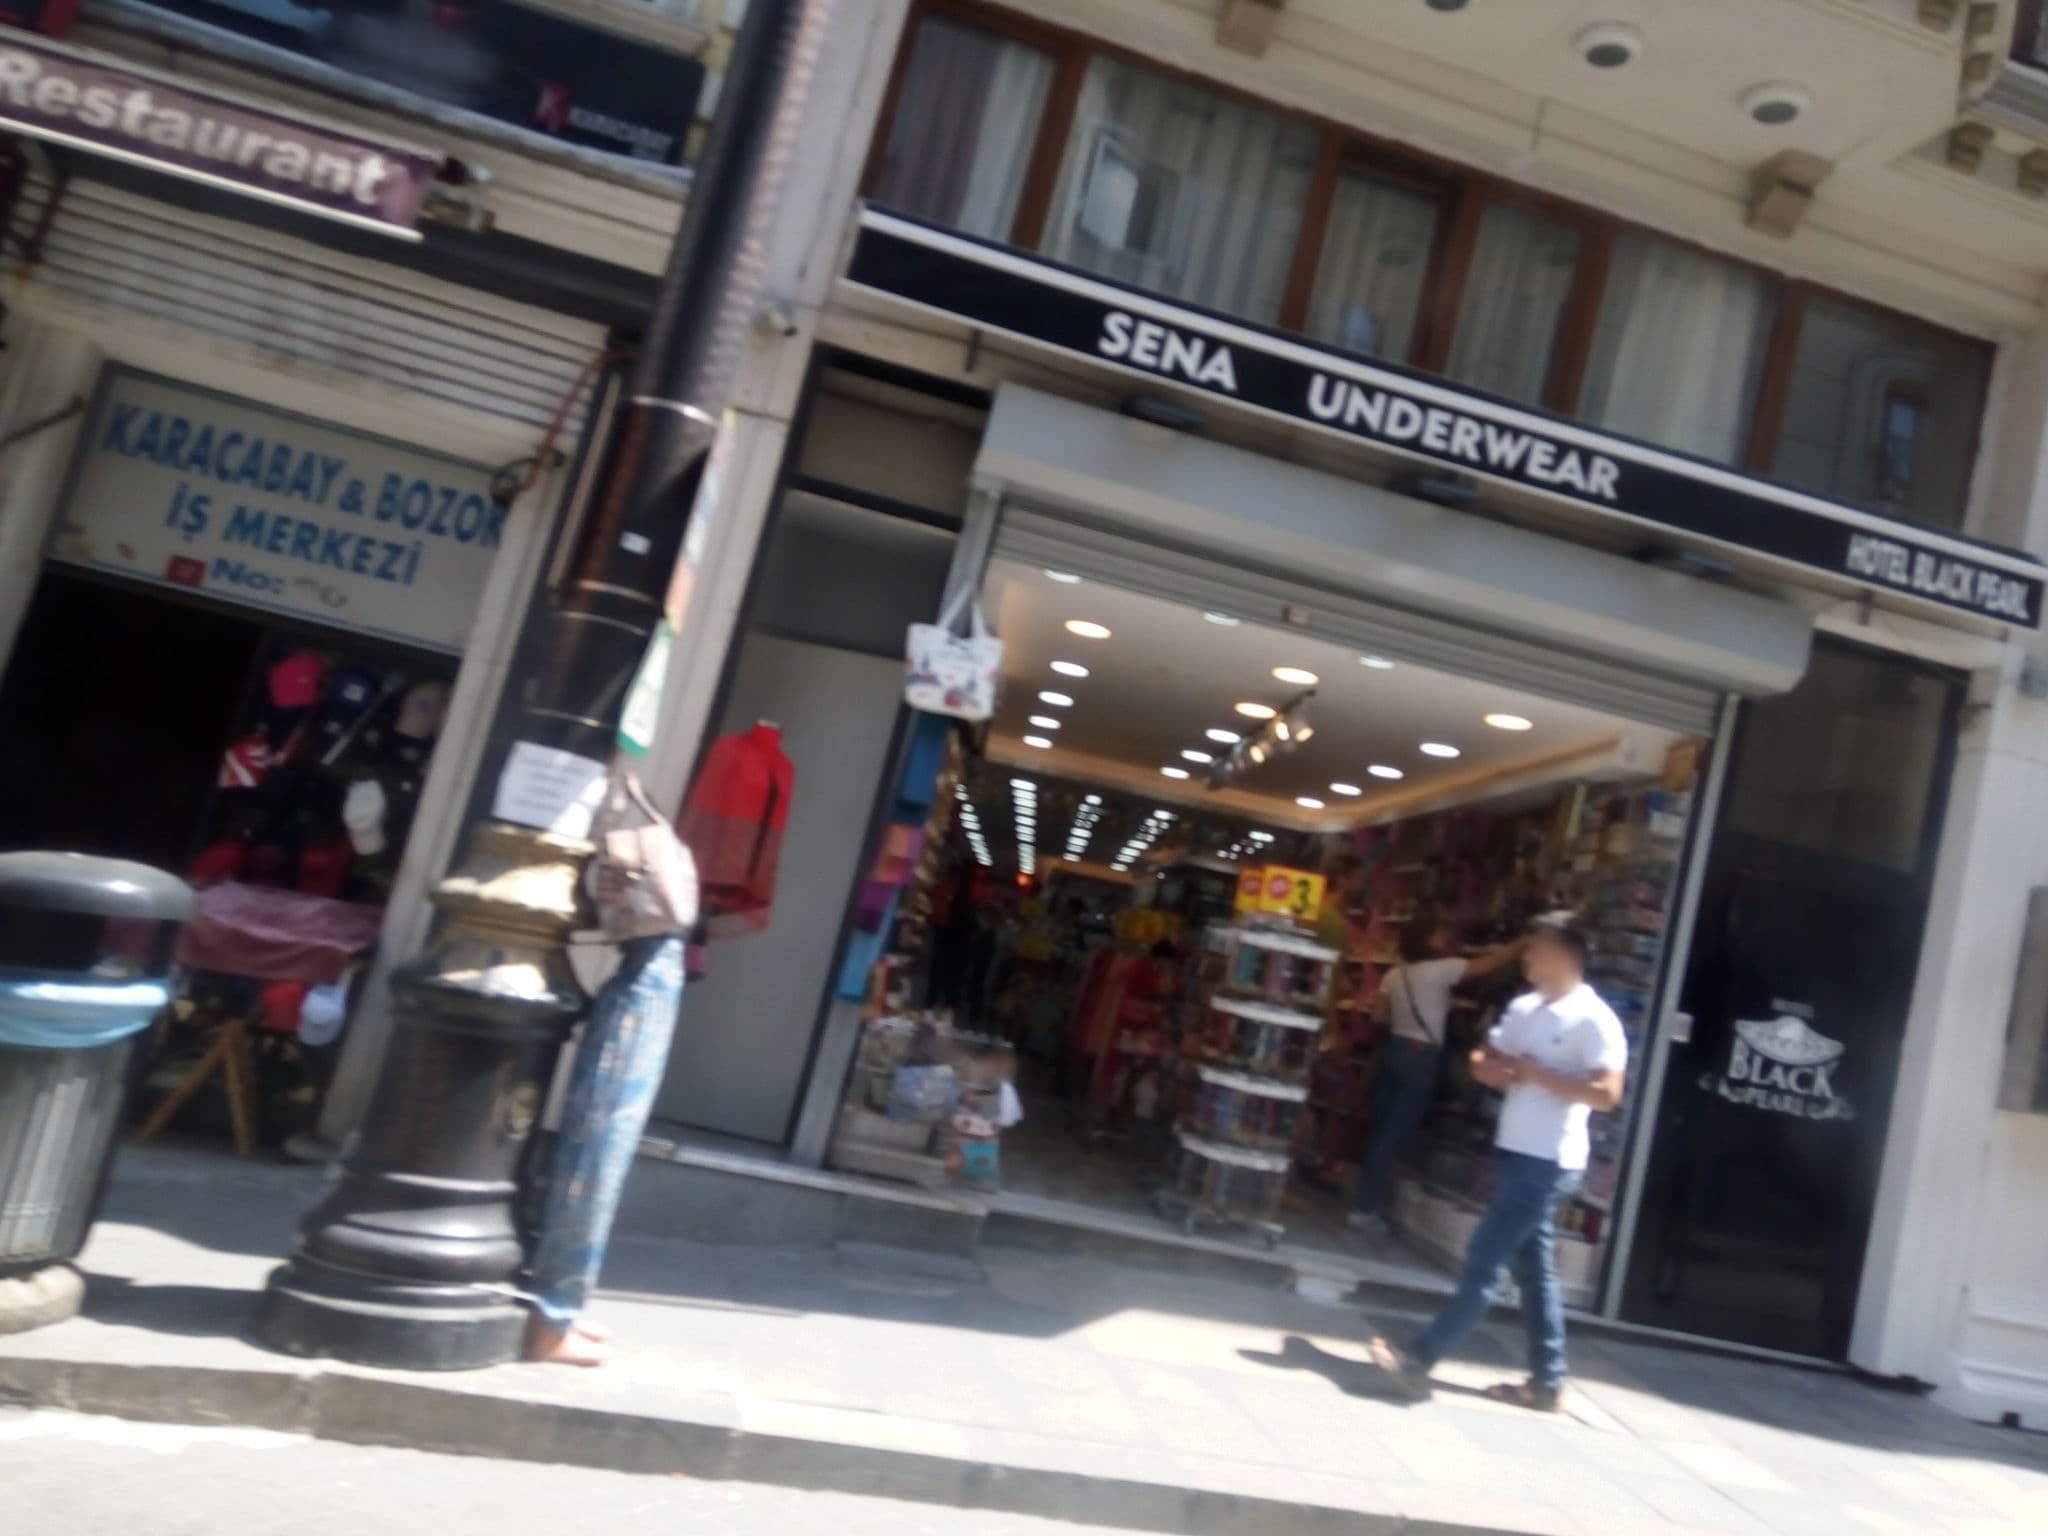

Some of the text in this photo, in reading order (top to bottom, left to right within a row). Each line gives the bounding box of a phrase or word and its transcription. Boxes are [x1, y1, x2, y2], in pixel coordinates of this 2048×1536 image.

[0, 46, 386, 205] Restaurant
[1099, 311, 1621, 500] SENA UNDERWEAR
[338, 477, 366, 516] &
[221, 504, 426, 585] MERKEZİ
[1847, 533, 1909, 585] HOTEL
[1912, 551, 1976, 602] BLACK
[1728, 1037, 1839, 1098] BLACK
